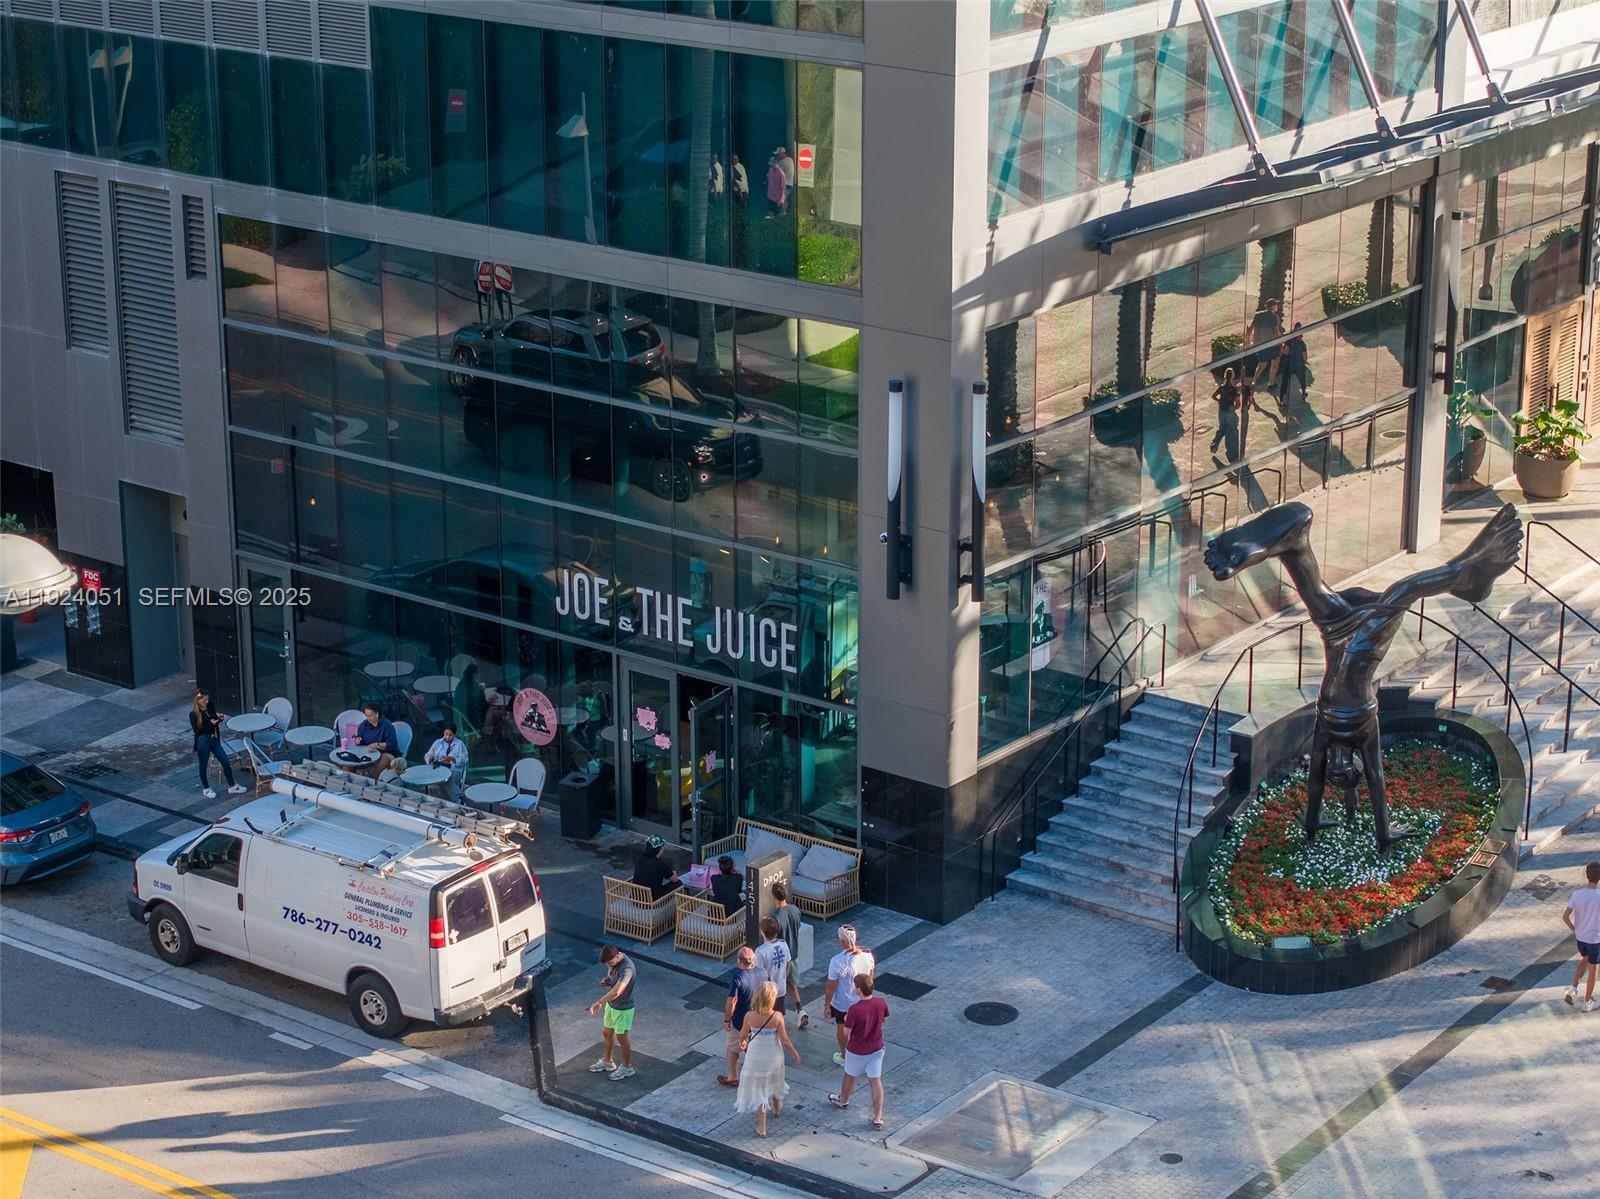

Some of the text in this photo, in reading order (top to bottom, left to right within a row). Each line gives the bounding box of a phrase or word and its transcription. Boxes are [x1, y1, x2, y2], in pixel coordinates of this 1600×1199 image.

[84, 570, 99, 581] FDC
[555, 569, 798, 673] JOE & THE JUICE
[747, 868, 756, 916] 1451
[763, 870, 784, 888] DROP
[344, 892, 364, 904] GENERAL
[364, 898, 389, 912] PLUMBING
[394, 906, 413, 919] SERVICE
[354, 905, 375, 916] LICENSED
[380, 913, 400, 923] INSURED
[282, 906, 382, 949] 786-277-0242
[346, 911, 408, 937] 305-558-1617
